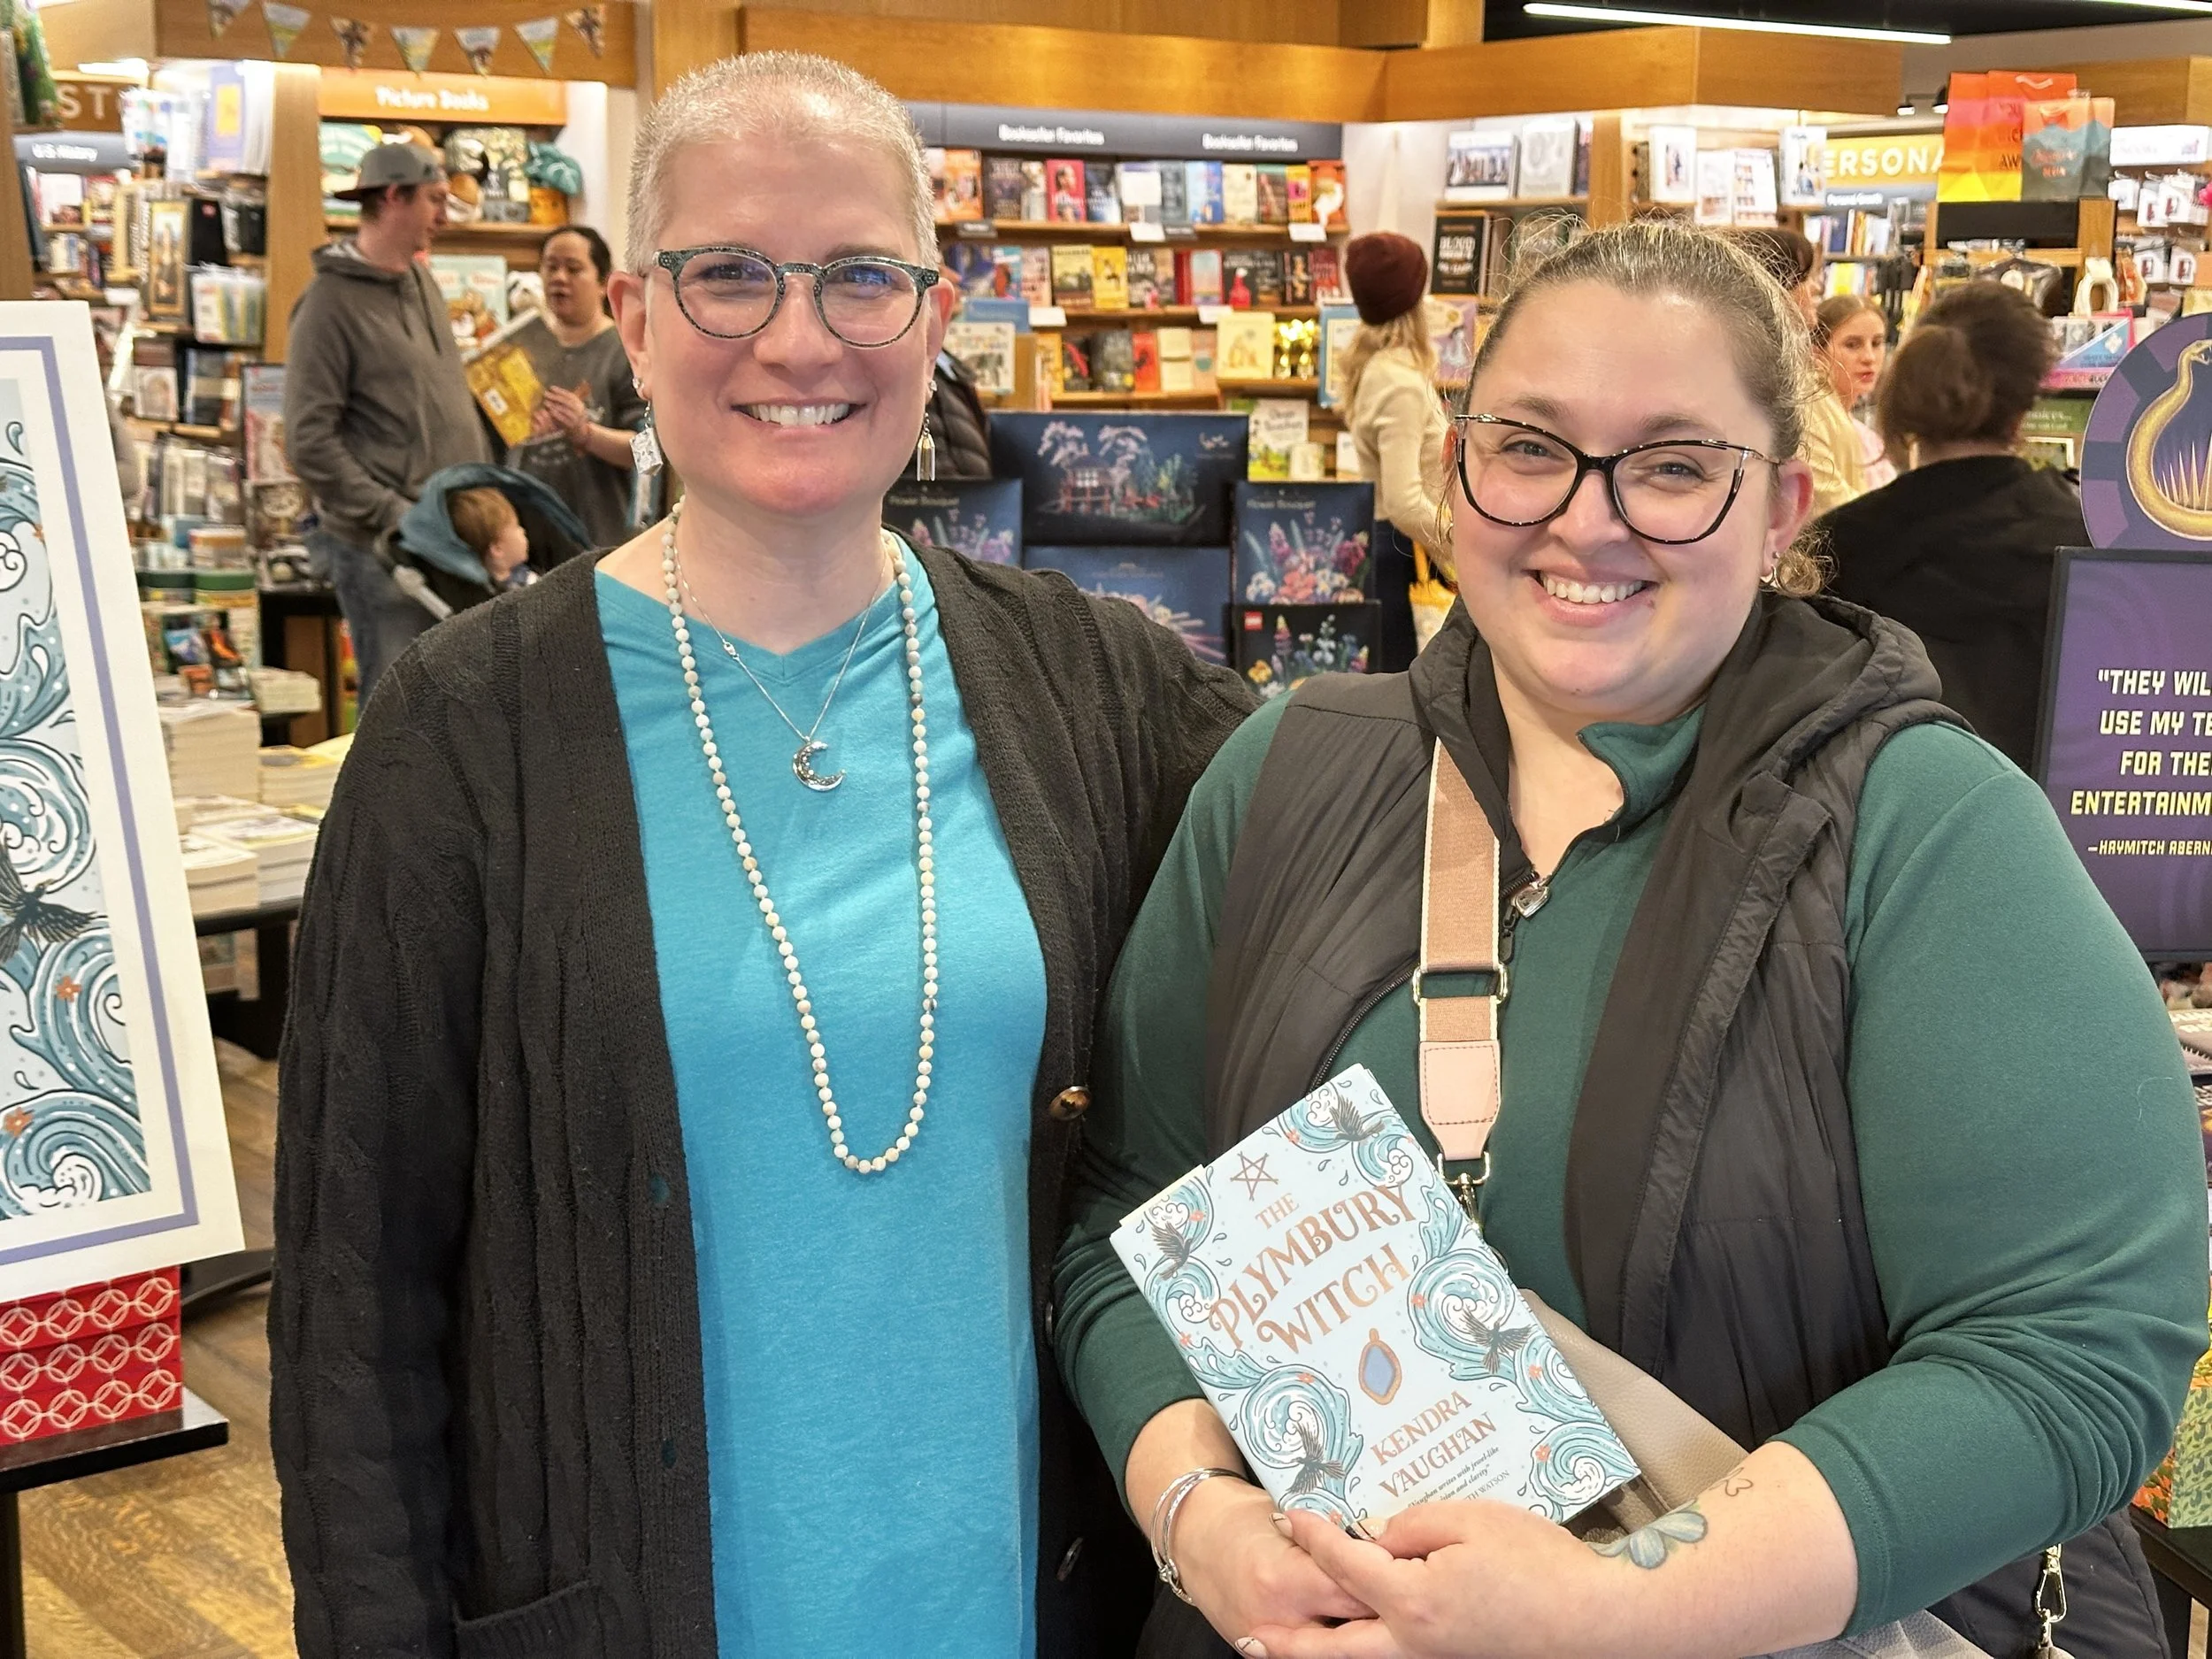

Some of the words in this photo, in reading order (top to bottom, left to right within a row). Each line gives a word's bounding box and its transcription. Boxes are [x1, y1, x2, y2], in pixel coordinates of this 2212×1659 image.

[57, 83, 112, 119] ST
[2098, 669, 2166, 695] "THEY
[2173, 671, 2212, 696] WIL
[2100, 710, 2144, 735] USE
[2149, 710, 2185, 736] MY
[2192, 711, 2212, 736] TE
[2120, 750, 2162, 776] FOR
[2170, 751, 2212, 776] THE
[2070, 790, 2212, 816] ENTERTAINM
[2169, 841, 2212, 856] ABERN
[1255, 1193, 1300, 1230] THE
[1209, 1180, 1417, 1350] PLYMBURY
[1256, 1242, 1410, 1355] WITCH
[1371, 1391, 1472, 1466] KENDRA
[1379, 1411, 1497, 1498] VAUGHAN
[1439, 1477, 1456, 1491] writes
[1456, 1465, 1471, 1478] with
[1455, 1479, 1468, 1494] and
[1478, 1470, 1510, 1494] WATSON
